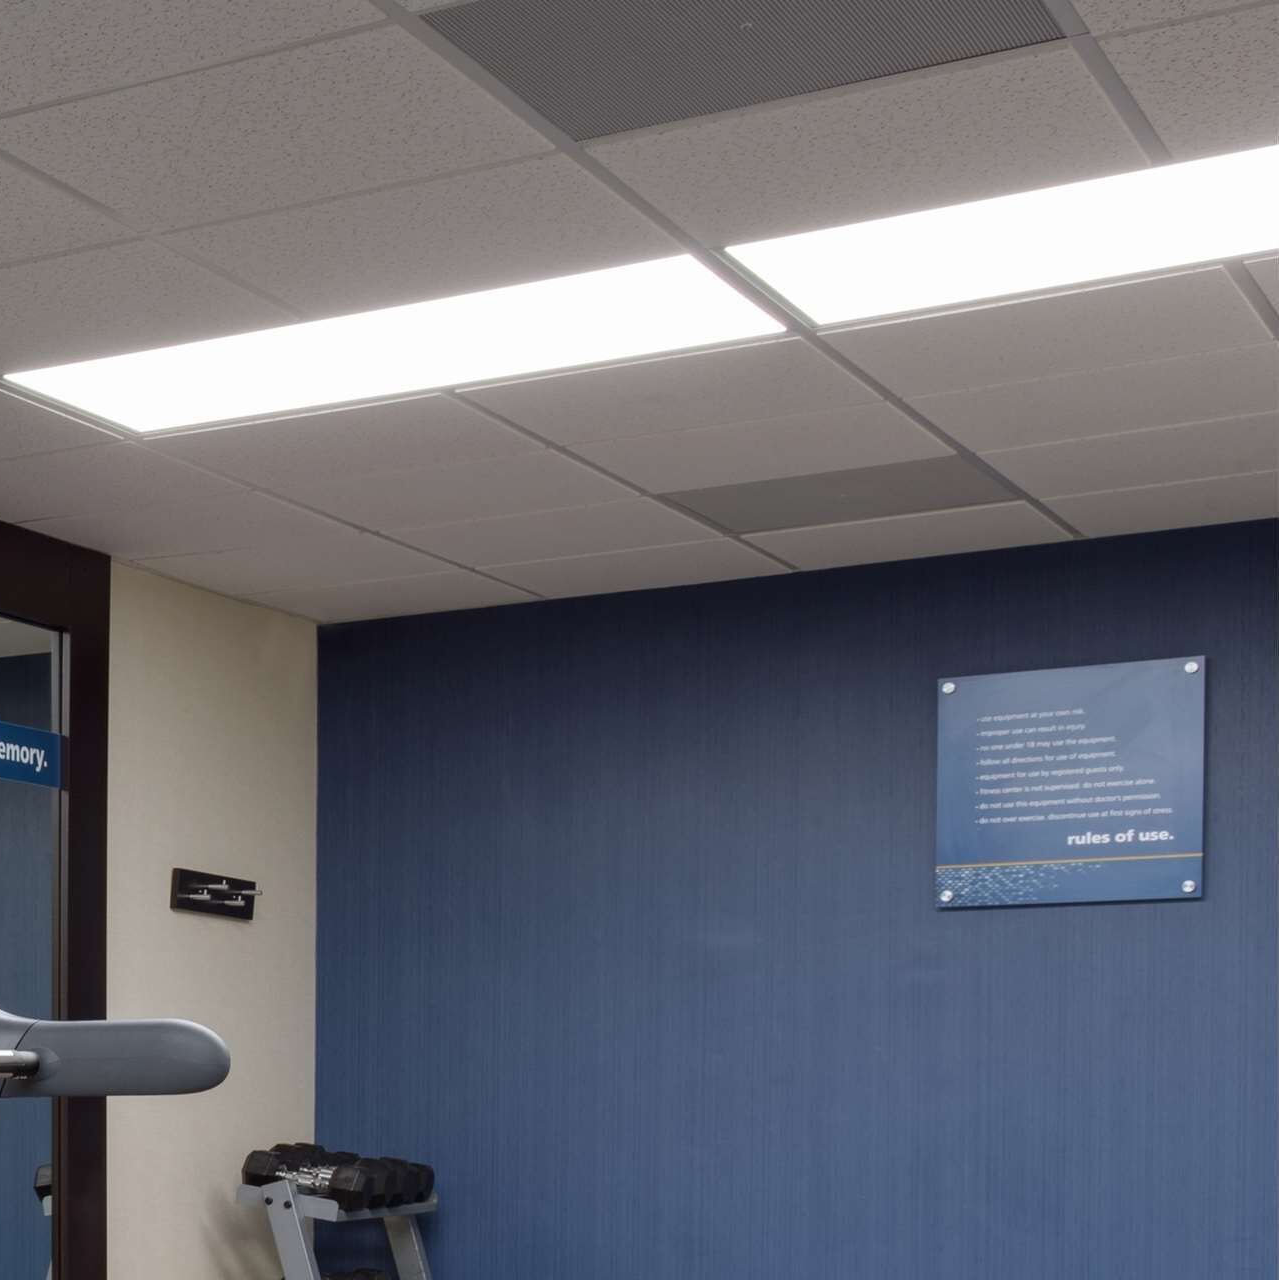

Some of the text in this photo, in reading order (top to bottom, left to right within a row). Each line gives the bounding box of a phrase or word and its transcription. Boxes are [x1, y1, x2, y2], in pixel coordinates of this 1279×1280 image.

[1067, 828, 1175, 846] rules of use.
